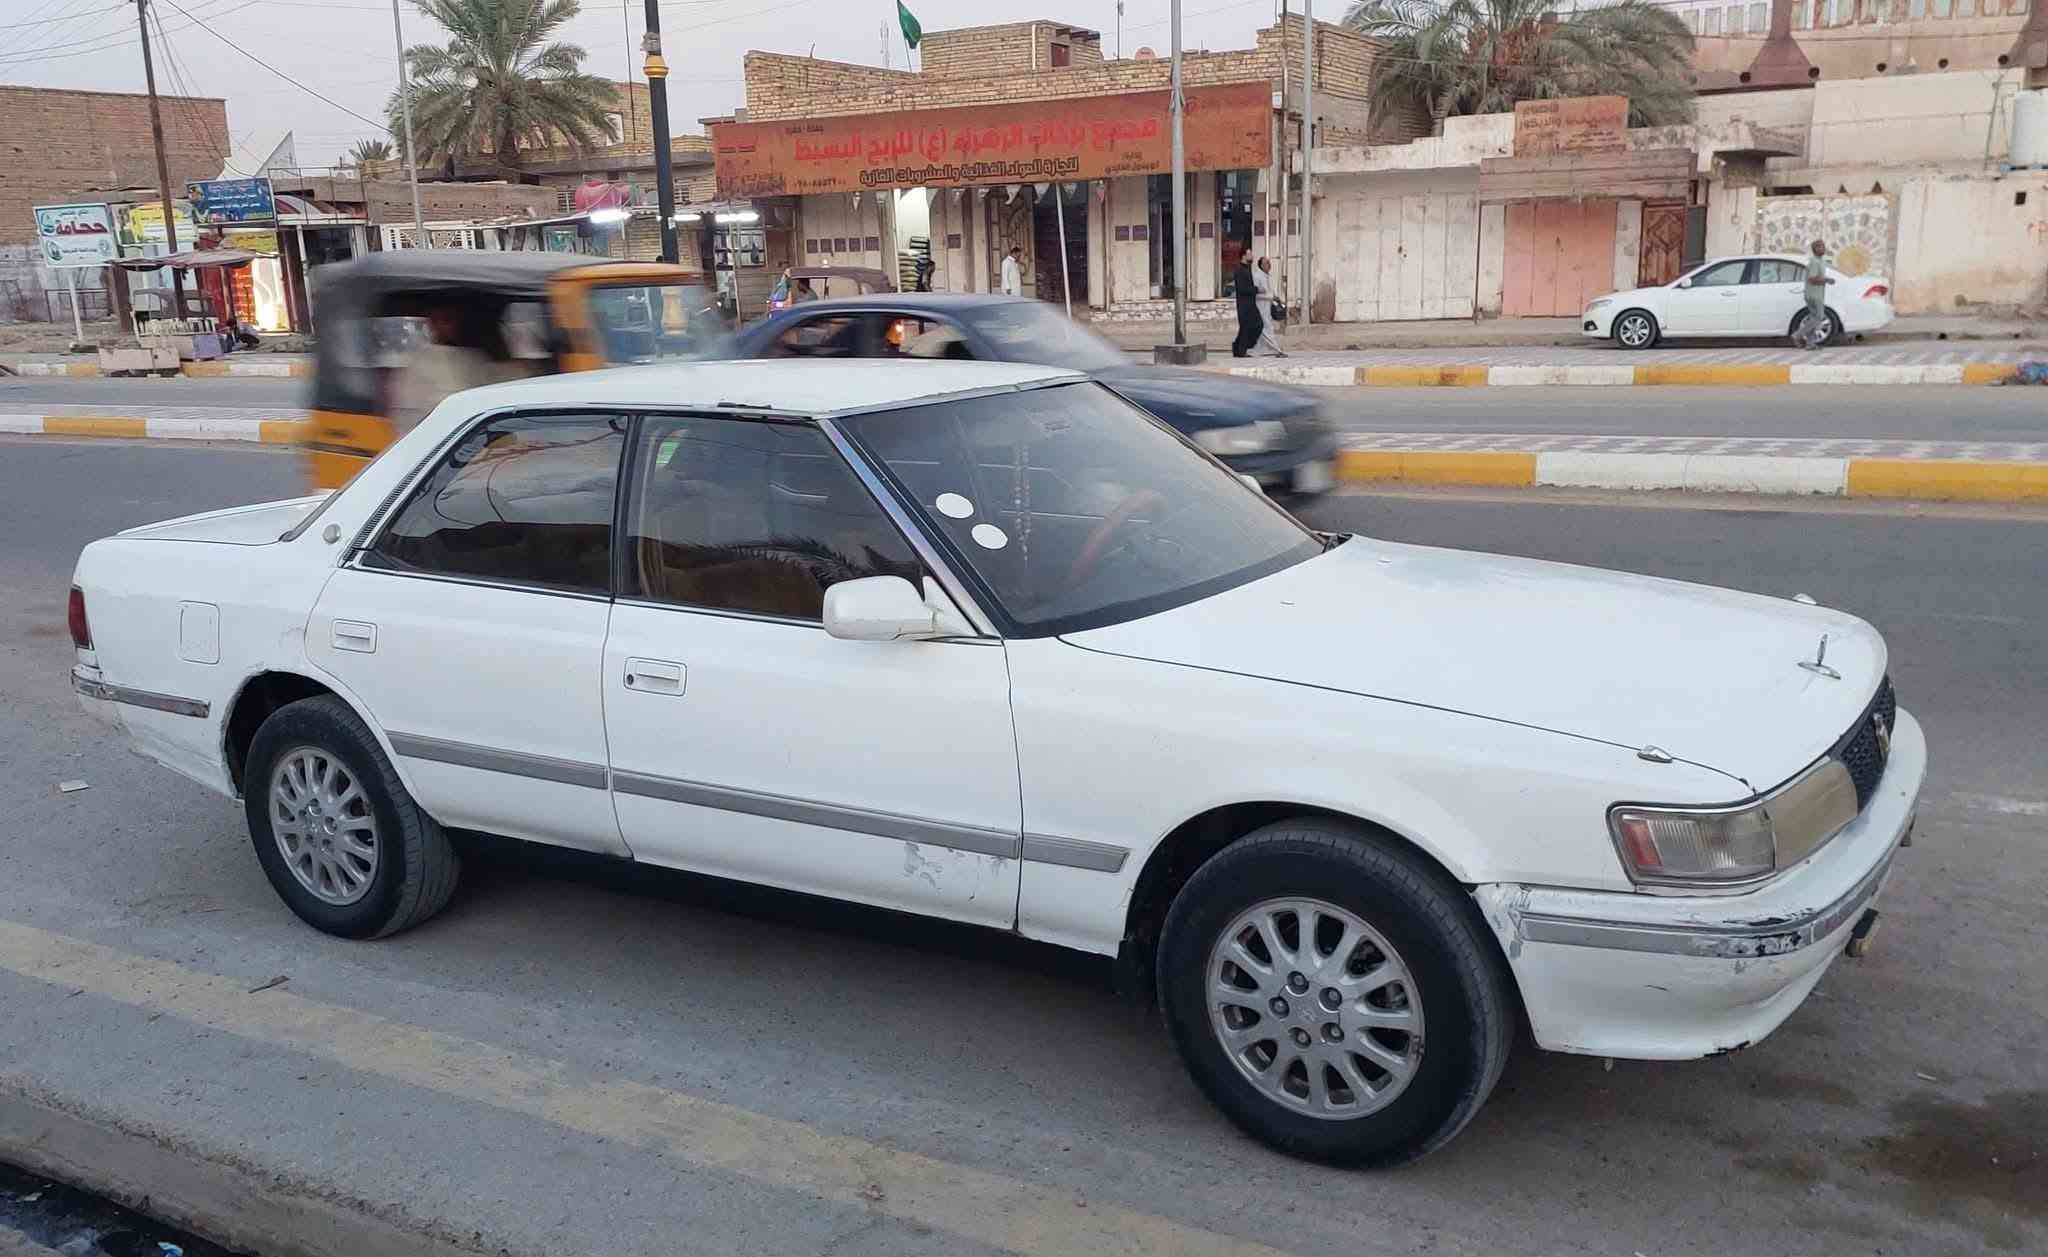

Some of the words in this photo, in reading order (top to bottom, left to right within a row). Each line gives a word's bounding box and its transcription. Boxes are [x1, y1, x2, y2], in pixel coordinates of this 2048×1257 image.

[795, 132, 862, 166] البسيط
[895, 163, 960, 185] والمشروبات
[961, 161, 1006, 181] الغذائية
[1007, 158, 1042, 179] المواد
[1043, 156, 1079, 176] لتجارة
[859, 168, 894, 187] الغازية
[56, 219, 108, 235] حجامة
